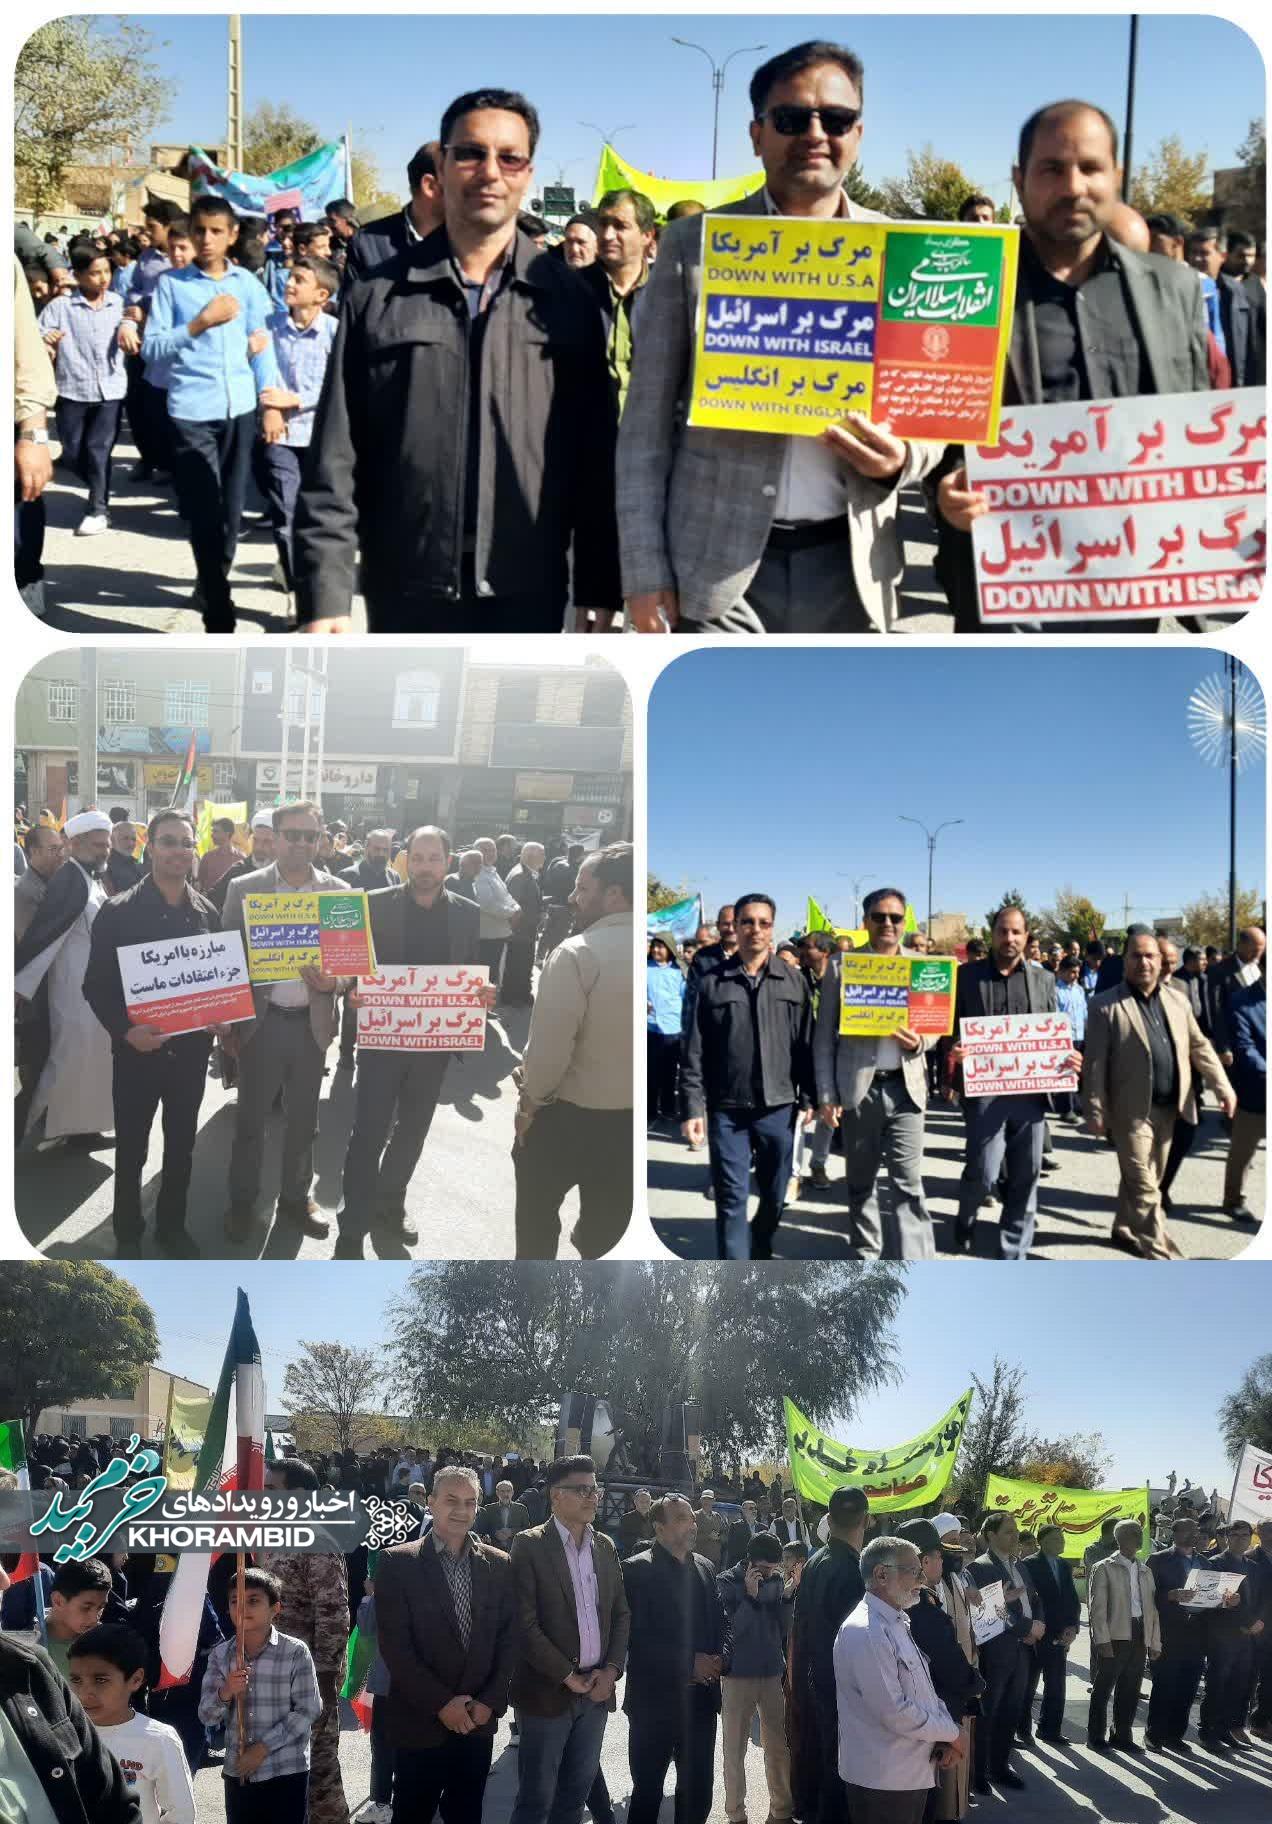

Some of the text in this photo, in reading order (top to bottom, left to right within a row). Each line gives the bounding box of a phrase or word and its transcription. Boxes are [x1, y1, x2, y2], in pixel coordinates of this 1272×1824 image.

[712, 230, 873, 266] مرگ بر آمریکا
[708, 268, 875, 288] DOWN WITH U.S.A
[707, 298, 874, 338] مرگ بر اسرائیل
[705, 333, 873, 357] DOWN WITH ISRAEL
[786, 375, 805, 396] بر
[812, 372, 865, 401] مرگ
[699, 397, 745, 411] DOWN
[751, 401, 789, 415] WITH
[976, 400, 1267, 471] مرگ بر آمریک
[984, 479, 1089, 507] DOWN
[1097, 472, 1185, 501] WITH
[980, 513, 1136, 575] اسرائیل
[1149, 524, 1184, 570] بر
[984, 572, 1266, 610] DOWN WITH ISRA
[287, 928, 296, 939] بر
[297, 925, 319, 938] مرگ
[191, 940, 226, 960] مبارزه
[169, 966, 218, 987] اعتقادات
[421, 975, 438, 992] بر
[446, 970, 483, 992] مرگ
[408, 995, 442, 1006] WITH
[447, 995, 481, 1006] U.S.A
[359, 1008, 482, 1033] مرگ بر اسرائیل
[965, 1017, 1010, 1040] آمریکا
[1017, 1023, 1029, 1038] بر
[1036, 1018, 1067, 1036] مرگ
[360, 1035, 481, 1047] DOWN WITH ISRAEL
[1006, 1041, 1037, 1052] WITH
[1039, 1040, 1069, 1050] U.S.A
[966, 1056, 1019, 1078] اسرائیل
[1024, 1060, 1036, 1076] بر
[967, 1077, 1074, 1092] DOWN WITH ISRAEL
